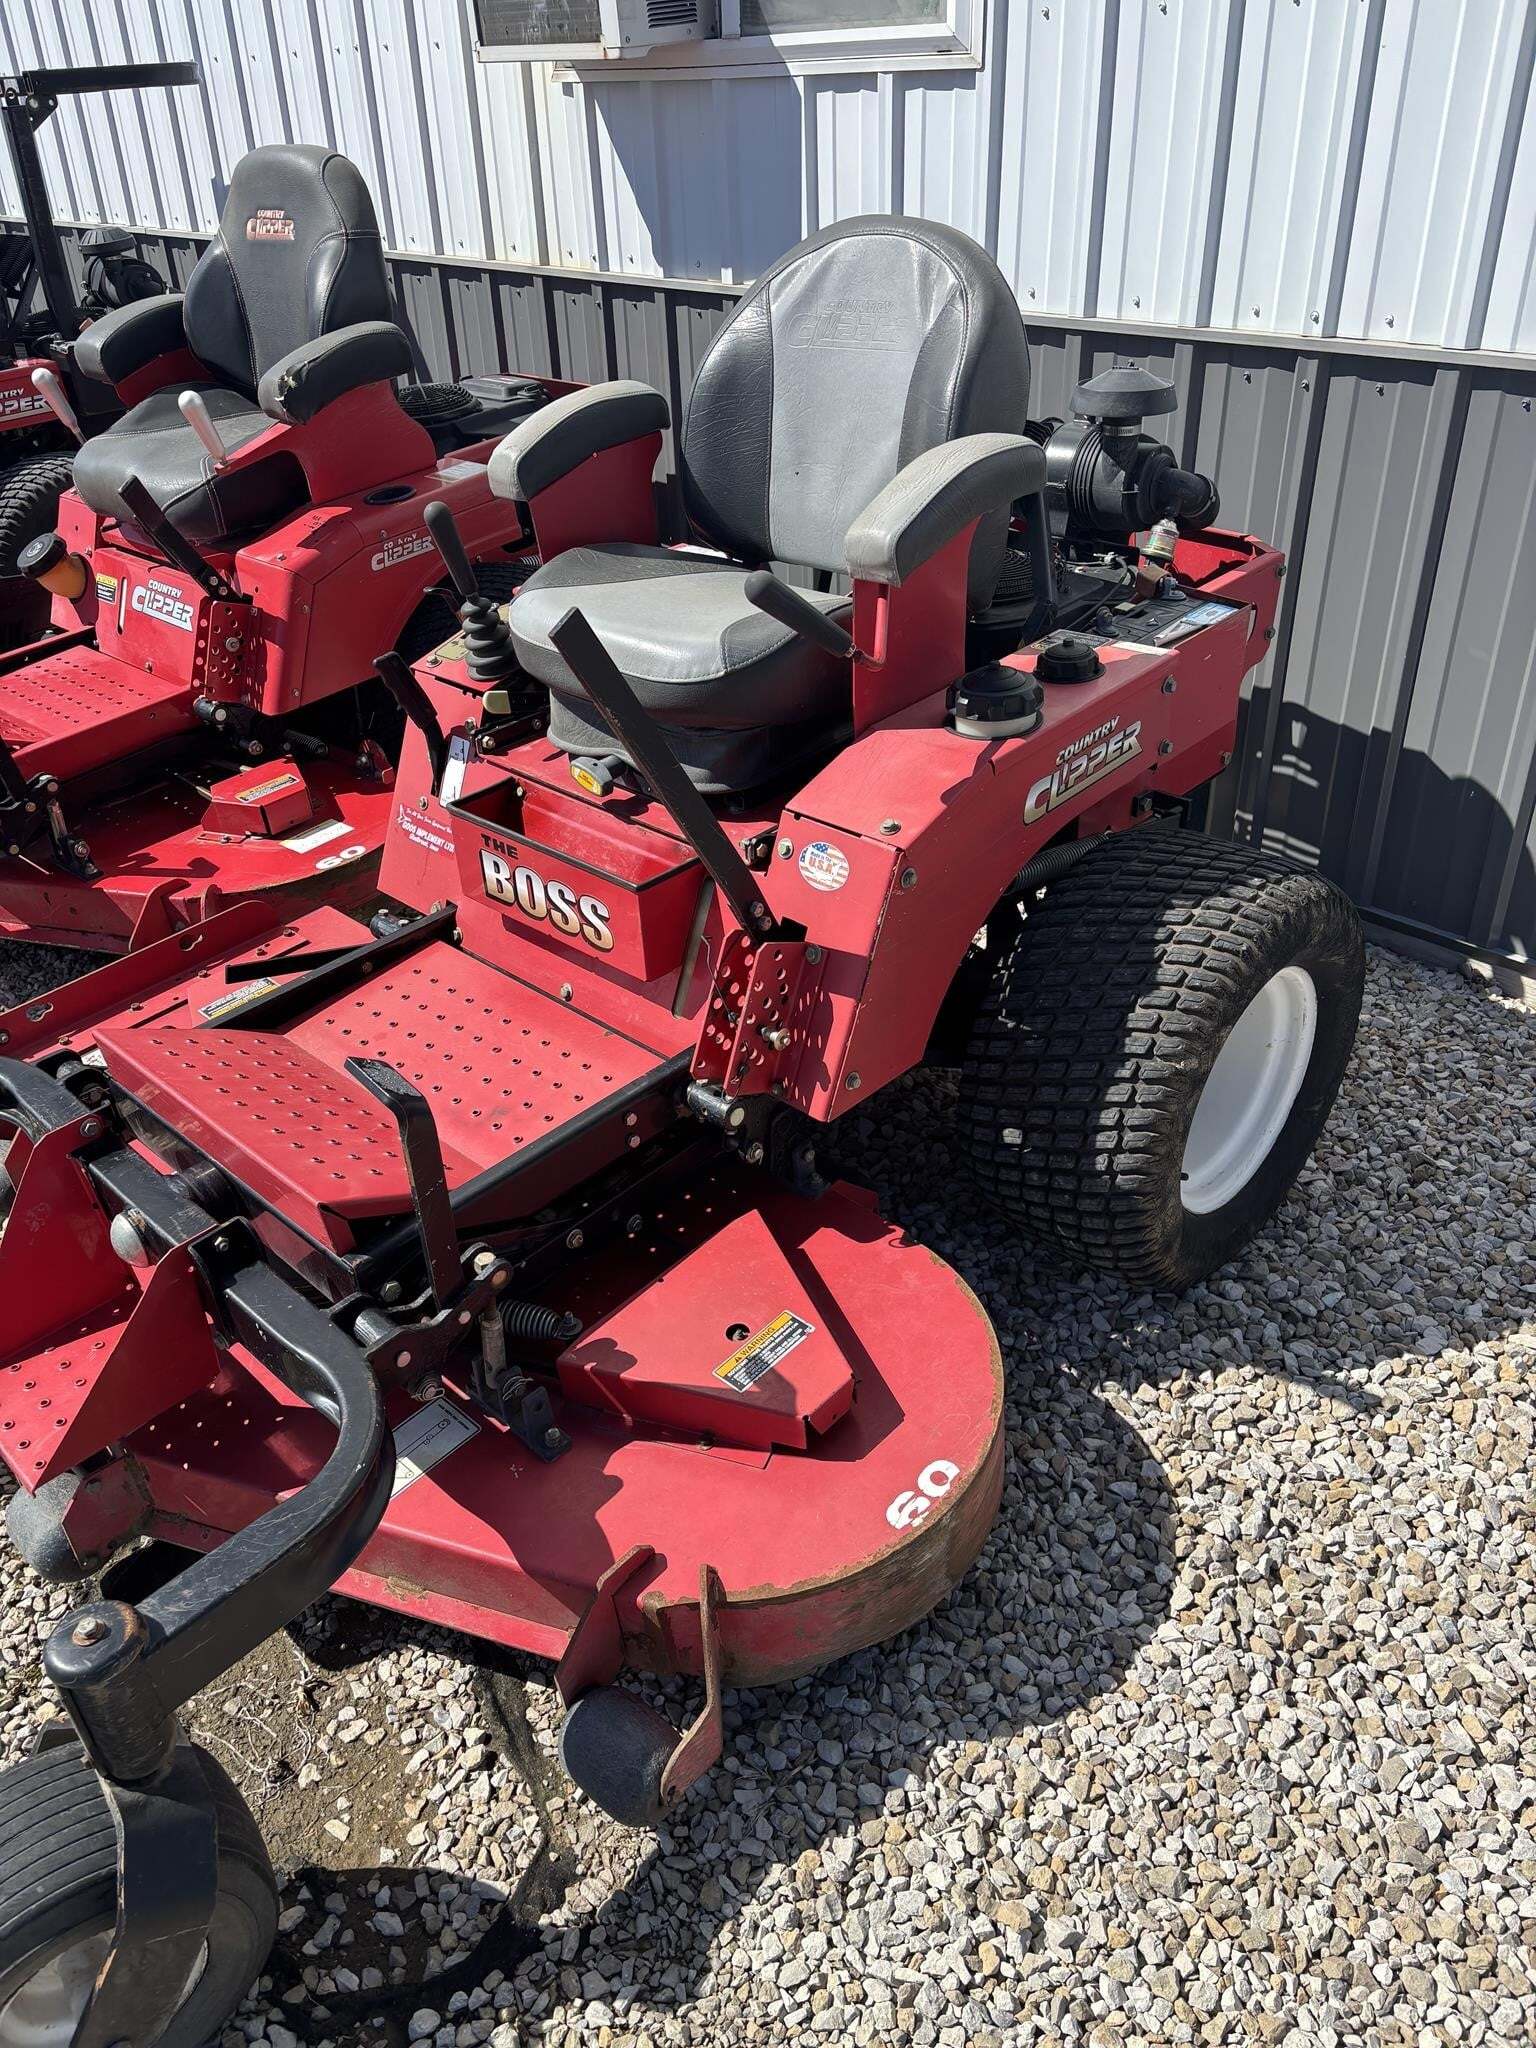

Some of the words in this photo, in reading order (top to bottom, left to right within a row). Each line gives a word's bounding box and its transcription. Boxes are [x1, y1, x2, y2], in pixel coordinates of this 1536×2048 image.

[371, 536, 436, 571] CLIPPER
[131, 585, 194, 631] CLIPPER
[148, 580, 182, 598] COUNTRY
[1056, 715, 1120, 766] COUNTRY
[1024, 720, 1143, 825] CLIPPER
[315, 845, 366, 869] 60
[481, 833, 519, 859] THE
[479, 848, 615, 953] BOSS
[741, 1327, 776, 1357] WARNING
[885, 1459, 960, 1530] 60
